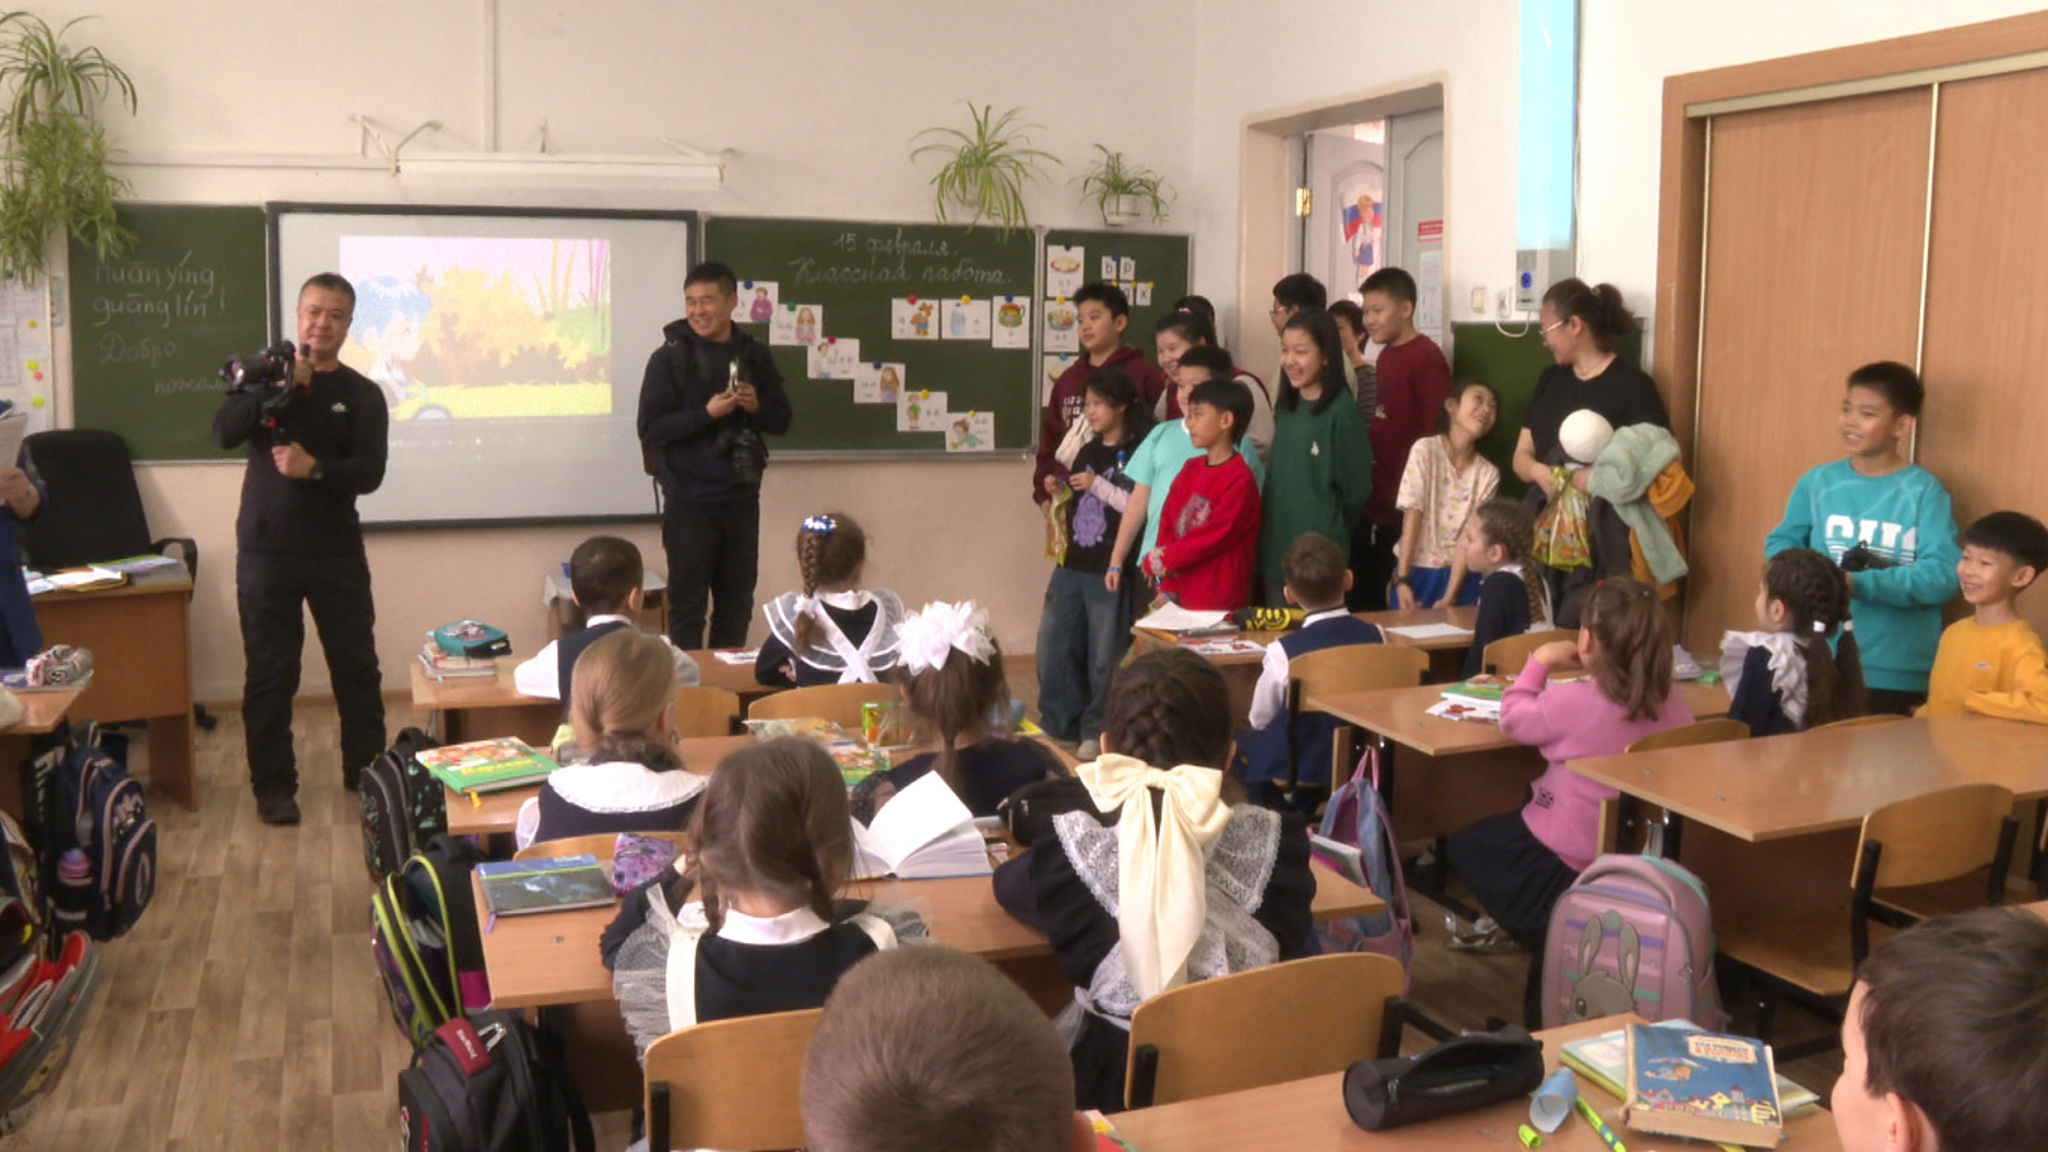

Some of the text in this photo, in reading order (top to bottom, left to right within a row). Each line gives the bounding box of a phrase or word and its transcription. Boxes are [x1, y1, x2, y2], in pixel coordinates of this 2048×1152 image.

[833, 232, 857, 253] 15
[787, 256, 910, 285] Классная
[99, 331, 177, 369] Добро
